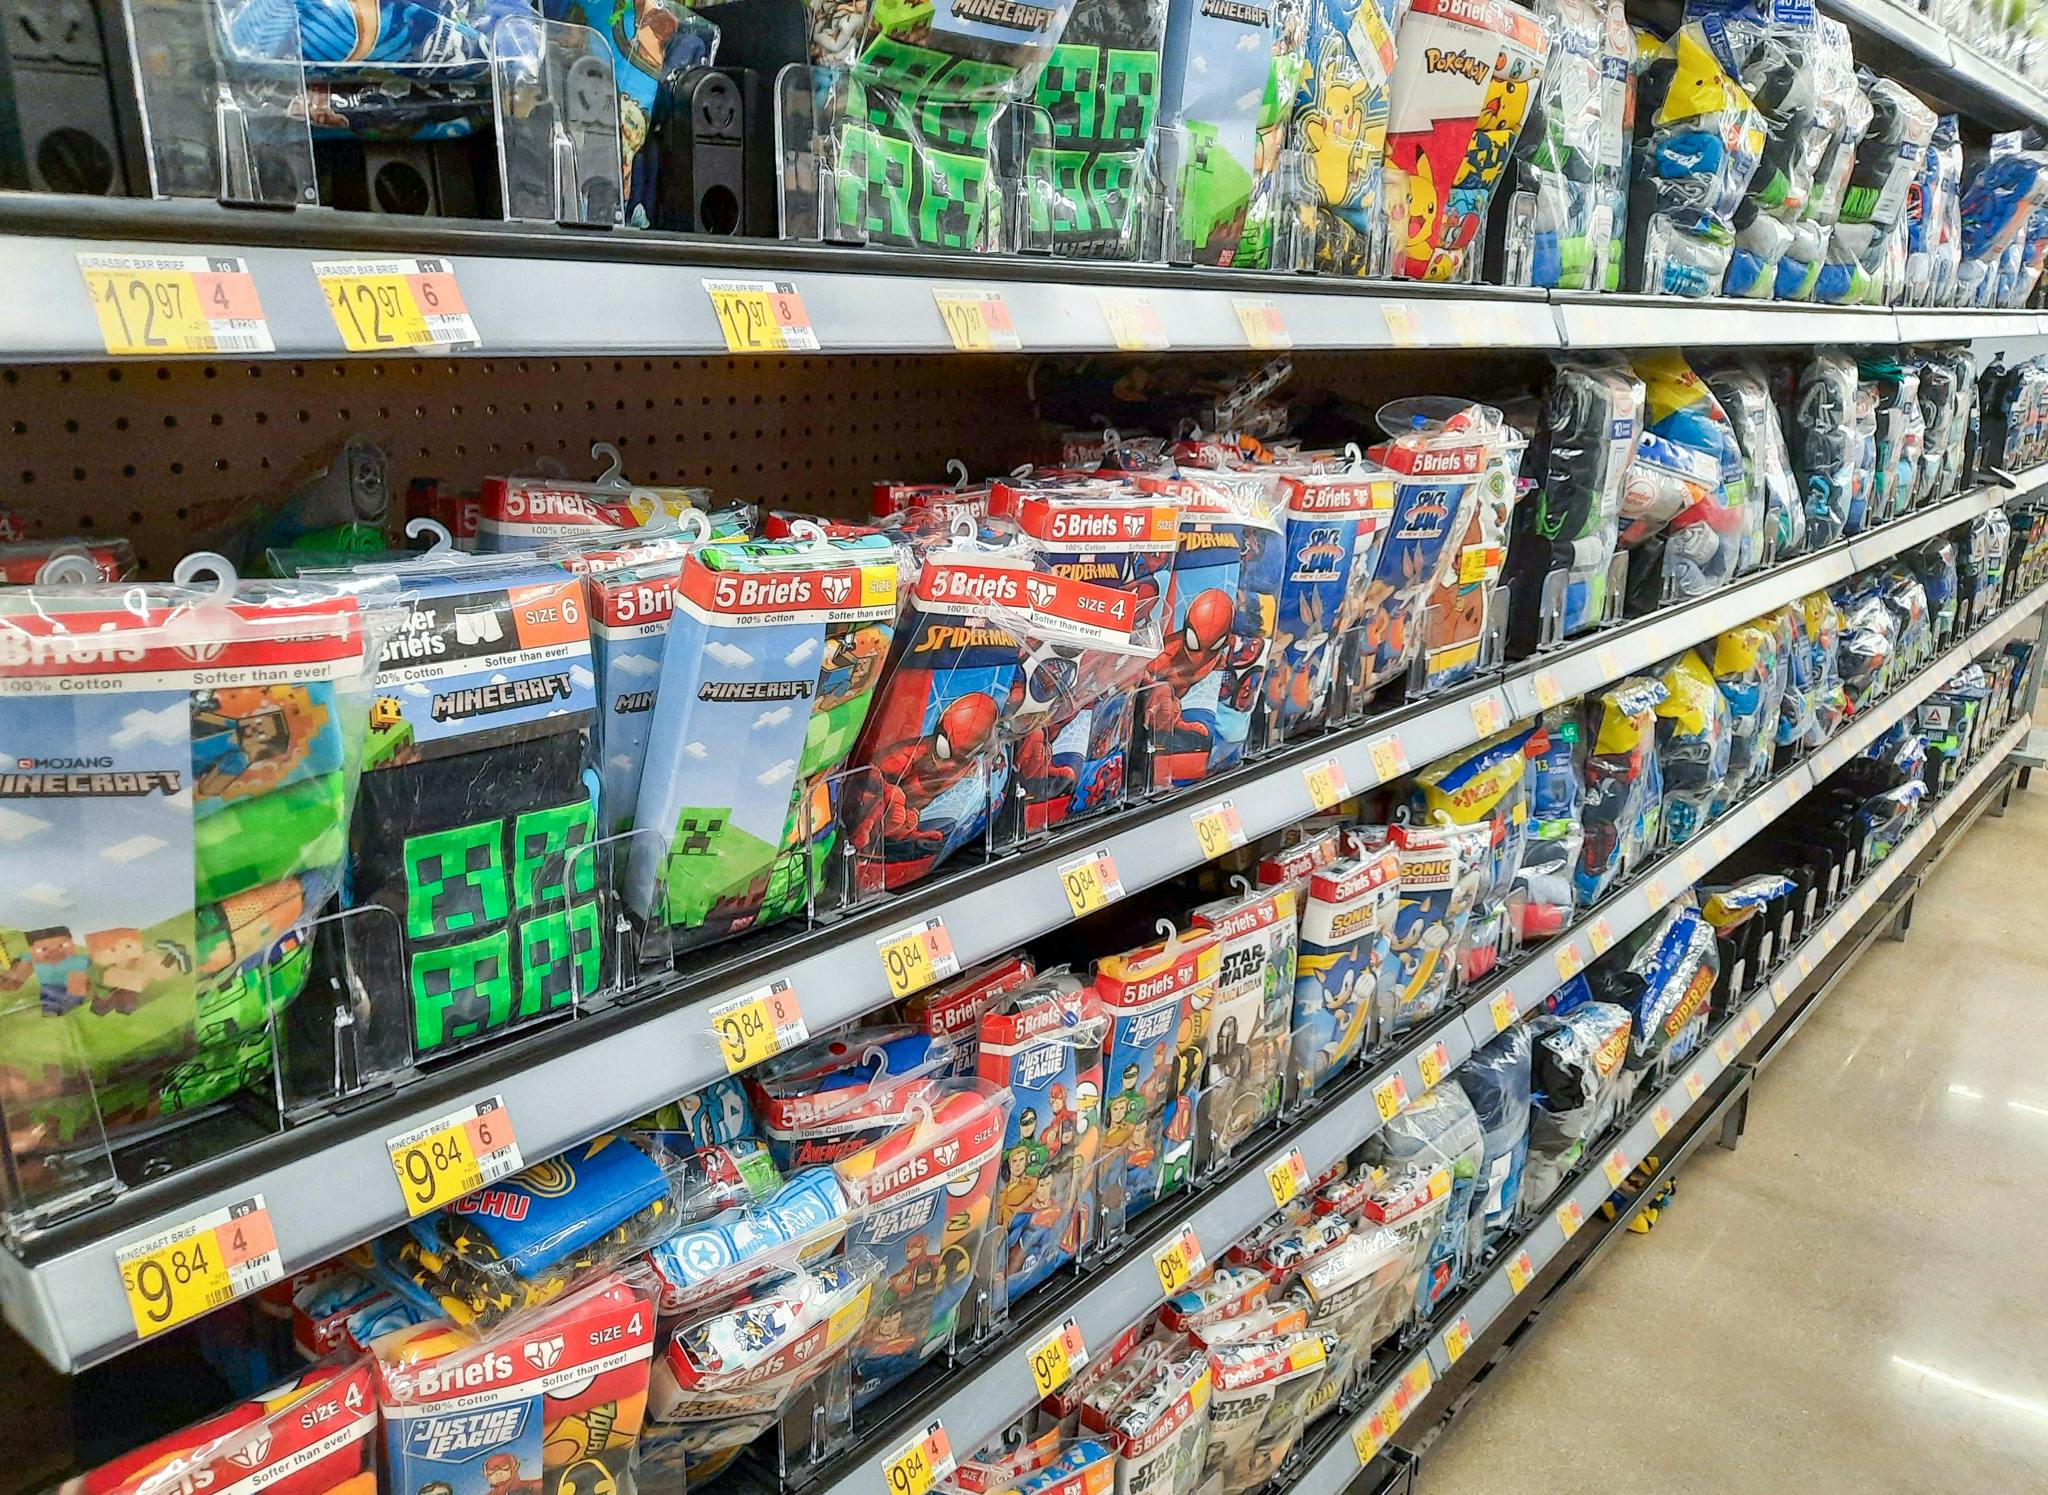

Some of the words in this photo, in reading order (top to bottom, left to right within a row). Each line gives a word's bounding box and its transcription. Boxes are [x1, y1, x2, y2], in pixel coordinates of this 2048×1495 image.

[950, 0, 1057, 33] MINECRAFT
[1200, 0, 1272, 28] MINECRAFT
[213, 282, 229, 310] 4
[422, 282, 440, 307] 6
[779, 301, 792, 320] 8
[1413, 453, 1424, 473] 5
[1423, 452, 1461, 471] Briefs
[506, 487, 526, 516] 5
[529, 491, 597, 516] Briefs
[1302, 488, 1315, 509] 5
[1315, 488, 1351, 509] Briefs
[464, 504, 480, 531] 5
[1052, 513, 1067, 537] 5
[1068, 513, 1118, 537] Briefs
[1156, 520, 1174, 530] SIZE
[1065, 544, 1083, 552] 100%
[1084, 543, 1106, 551] Cotton
[716, 578, 737, 607] 5
[739, 576, 812, 607] Briefs
[869, 580, 893, 593] SIZE
[931, 569, 948, 598] 5
[950, 571, 1018, 600] Briefs
[1077, 596, 1106, 614] SIZE
[1109, 599, 1126, 621] 4
[525, 607, 558, 625] SIZE
[561, 597, 579, 625] 6
[616, 591, 636, 621] 5
[736, 614, 761, 625] 100%
[764, 613, 795, 623] Cotton
[829, 609, 855, 620] Softer
[856, 609, 874, 618] than
[640, 623, 664, 635] 100%
[946, 604, 970, 615] 100%
[1033, 613, 1058, 627] Softer
[1059, 620, 1078, 631] than
[1079, 625, 1102, 637] ever!
[404, 667, 444, 680] Cotton
[485, 655, 517, 668] Softer
[520, 651, 543, 663] than
[545, 646, 569, 658] ever!
[59, 677, 123, 691] Cotton
[193, 670, 248, 685] Softer
[251, 667, 288, 681] than
[294, 664, 332, 678] ever!
[697, 679, 815, 702] MINECRAFT
[430, 671, 573, 723] MINECRAFT
[33, 756, 113, 769] MOJANG
[0, 770, 181, 798] INECRAFT
[1099, 863, 1108, 878] 6
[1401, 859, 1451, 876] SONIC
[1335, 883, 1345, 899] 5
[1344, 874, 1371, 897] Briefs
[1225, 911, 1258, 939] Briefs
[1333, 902, 1375, 930] SONIC
[930, 935, 939, 952] 4
[1220, 943, 1266, 973] STAR
[1218, 957, 1265, 988] WARS
[1124, 984, 1137, 1004] 5
[1137, 973, 1175, 1001] Briefs
[774, 1001, 785, 1019] 8
[931, 1011, 944, 1034] 5
[1015, 1017, 1024, 1040] 5
[1024, 1007, 1061, 1034] Briefs
[1129, 1006, 1174, 1034] JUSTICE
[1135, 1019, 1173, 1047] LEAGUE
[1020, 1043, 1063, 1071] JUSTICE
[1024, 1058, 1062, 1087] LEAGUE
[481, 1103, 492, 1114] 20
[781, 1105, 794, 1127] 5
[388, 1130, 429, 1151] MINECRAFT
[431, 1120, 451, 1135] BRIEF
[479, 1123, 492, 1146] 6
[872, 1155, 928, 1196] Briefs
[974, 1128, 993, 1145] SIZE
[992, 1117, 1001, 1134] 4
[894, 1186, 921, 1201] Cotton
[236, 1204, 250, 1217] 19
[866, 1194, 934, 1230] JUSTICE
[232, 1227, 247, 1251] 4
[873, 1212, 930, 1245] LEAGUE
[116, 1236, 168, 1261] MINECRAFT
[171, 1225, 197, 1242] BRIEF
[1185, 1241, 1192, 1255] 8
[418, 1352, 513, 1397] Briefs
[589, 1327, 622, 1346] SIZE
[627, 1312, 643, 1337] 4
[1065, 1335, 1074, 1349] 6
[420, 1401, 454, 1415] 100%
[457, 1393, 498, 1408] Cotton
[542, 1373, 574, 1388] Softer
[577, 1363, 600, 1377] than
[602, 1354, 628, 1370] ever!
[300, 1400, 340, 1429] SIZE
[343, 1382, 363, 1408] 4
[414, 1406, 521, 1441] JUSTICE
[1132, 1438, 1143, 1457] 5
[1143, 1415, 1174, 1448] Briefs
[426, 1425, 513, 1460] LEAGUE
[931, 1439, 939, 1455] 4
[252, 1461, 290, 1487] Softer
[291, 1447, 320, 1468] than
[322, 1429, 351, 1457] ever!
[1137, 1443, 1177, 1476] STAR
[1129, 1456, 1173, 1494] WARS
